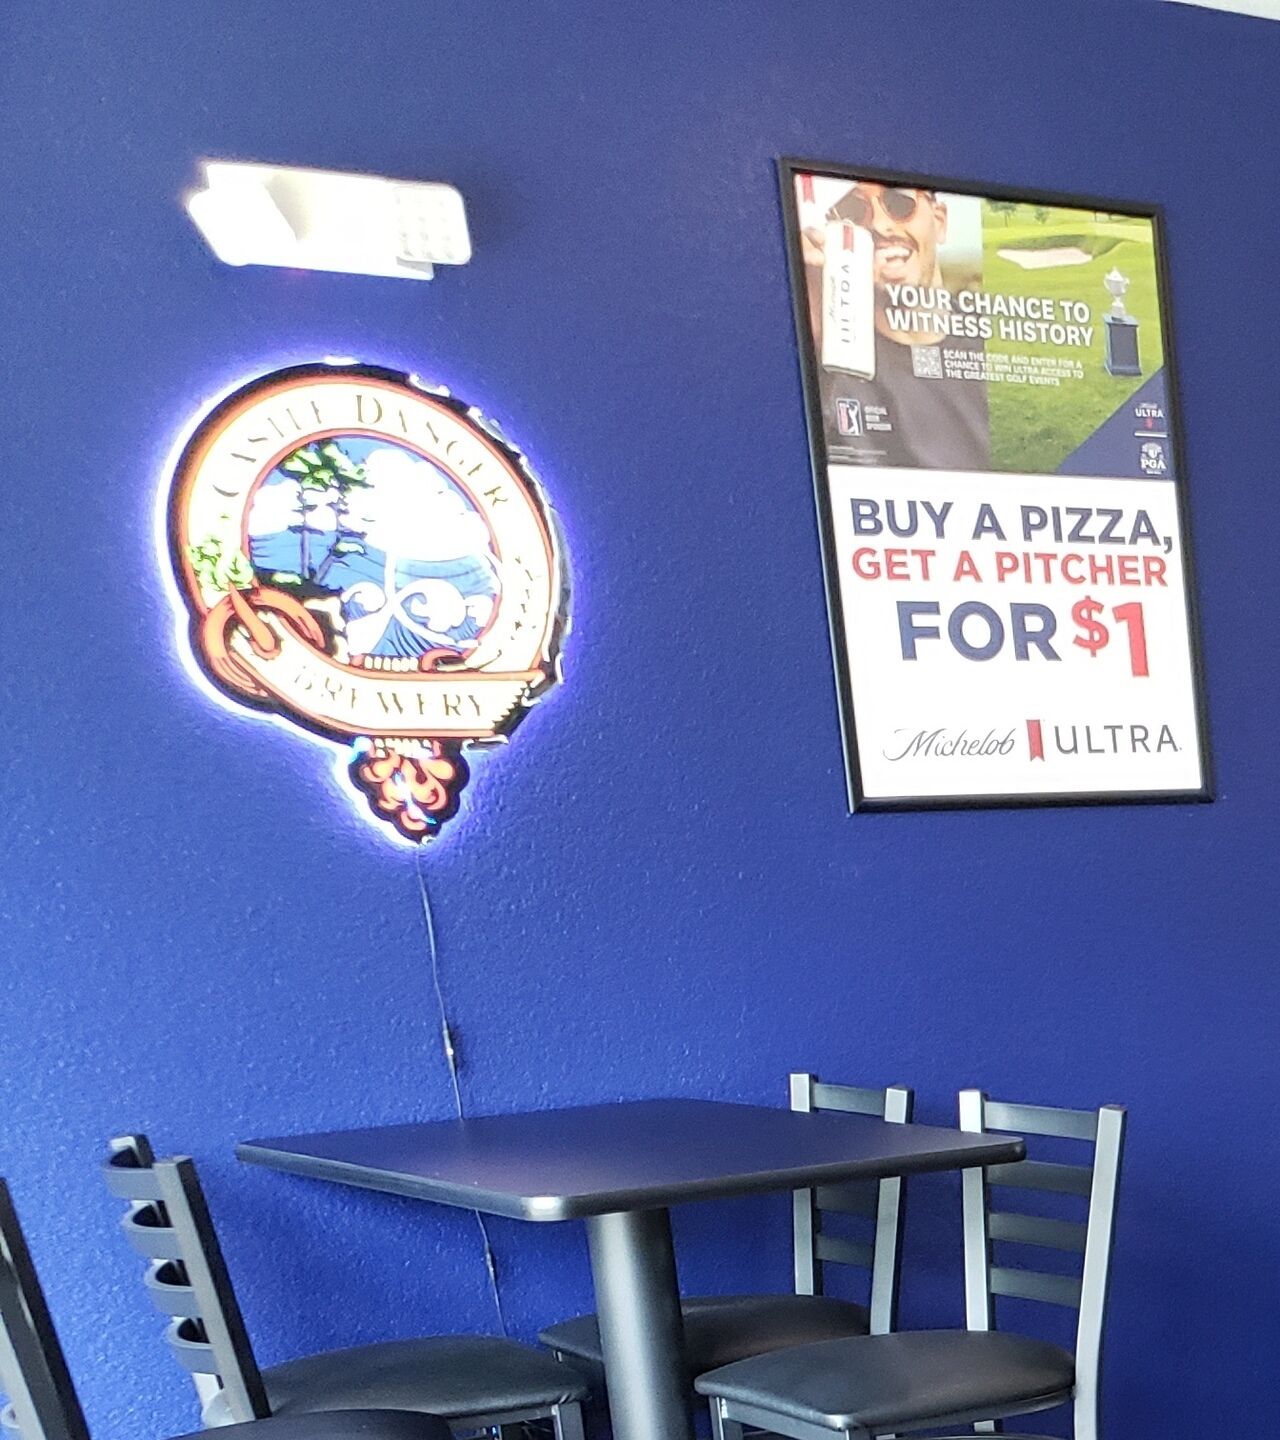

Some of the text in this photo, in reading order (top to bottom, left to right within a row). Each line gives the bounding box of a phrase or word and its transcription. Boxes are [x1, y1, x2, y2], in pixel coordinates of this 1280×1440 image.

[885, 284, 1091, 323] YOUR CHANCE TO
[886, 308, 1094, 347] WITNESS HISTORY
[943, 349, 967, 360] SCAN
[969, 351, 984, 361] THE
[1076, 360, 1083, 369] A
[944, 360, 1084, 379] CHANCE TO WIN ULTRA ACCESS TO
[945, 369, 962, 379] THE
[1029, 375, 1060, 386] EVENTS
[1135, 408, 1164, 418] ULTRA
[850, 498, 1173, 554] BUY A PIZZA,
[852, 547, 1168, 587] GET A PITCHER
[896, 595, 1150, 678] FOR $1
[882, 724, 1178, 761] Michelob ULTRA
